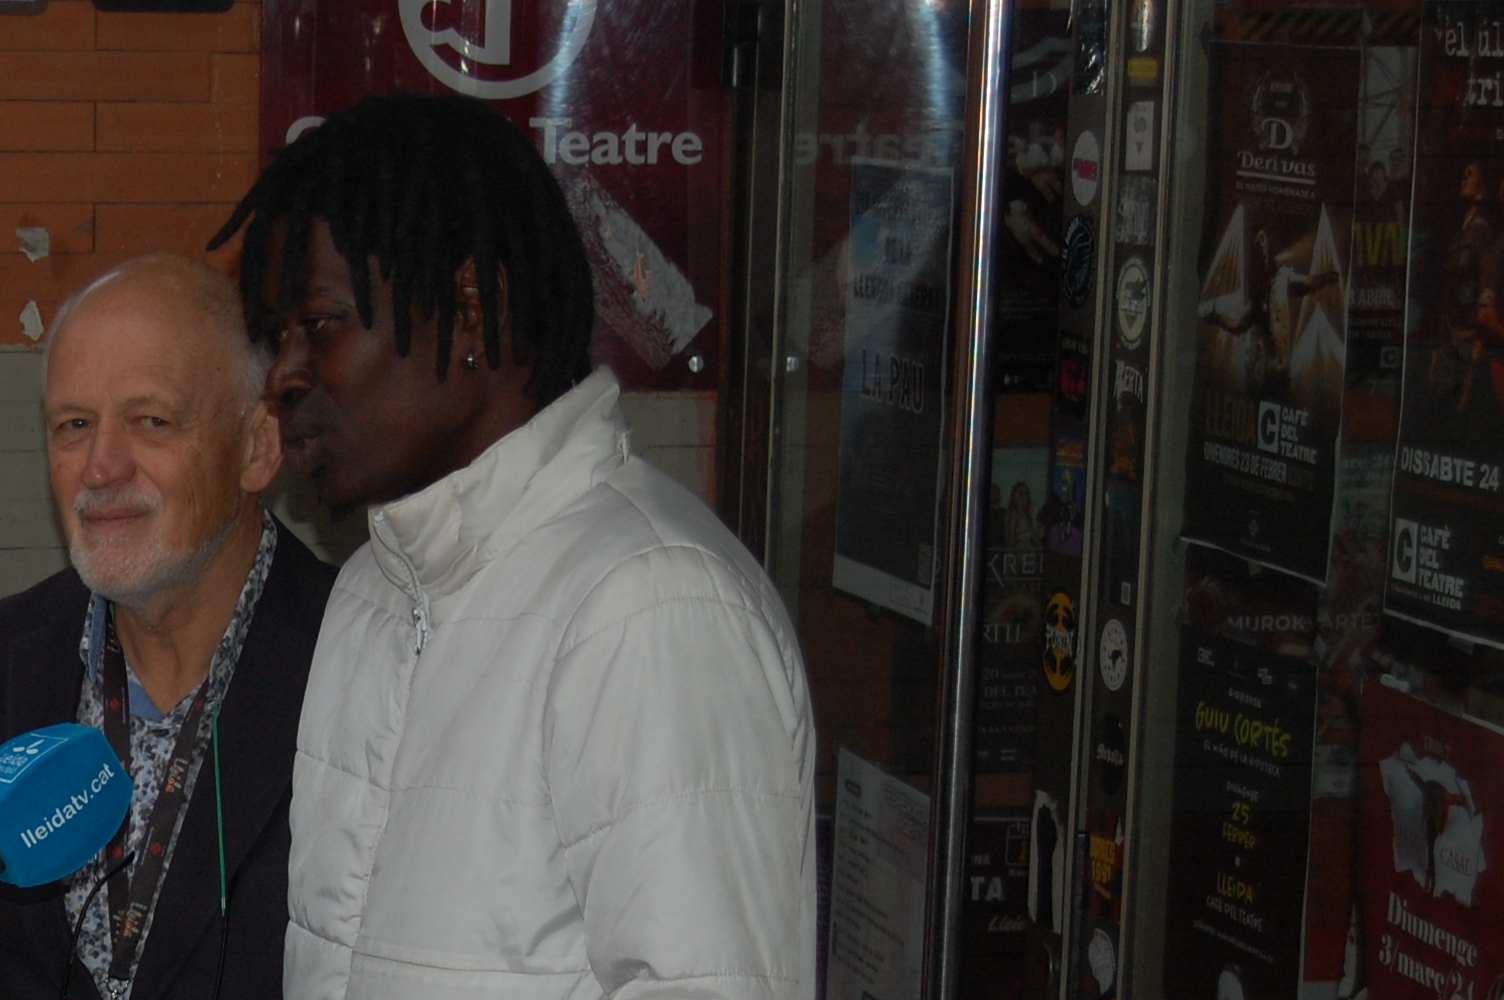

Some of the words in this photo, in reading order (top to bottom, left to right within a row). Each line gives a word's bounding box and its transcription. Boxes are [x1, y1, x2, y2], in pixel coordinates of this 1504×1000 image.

[529, 117, 703, 166] Teatre
[1237, 150, 1316, 177] Derivas
[888, 352, 924, 413] PAU
[1280, 440, 1316, 464] TEATRE
[1401, 446, 1475, 488] DISSABTE
[1478, 463, 1499, 492] 24
[1419, 547, 1439, 570] DEL
[1418, 567, 1464, 599] TEATRE
[1234, 713, 1291, 759] CORTÉS
[20, 762, 115, 849] lleidatv.cat
[1232, 801, 1250, 826] 25
[1387, 890, 1477, 967] Diumenge
